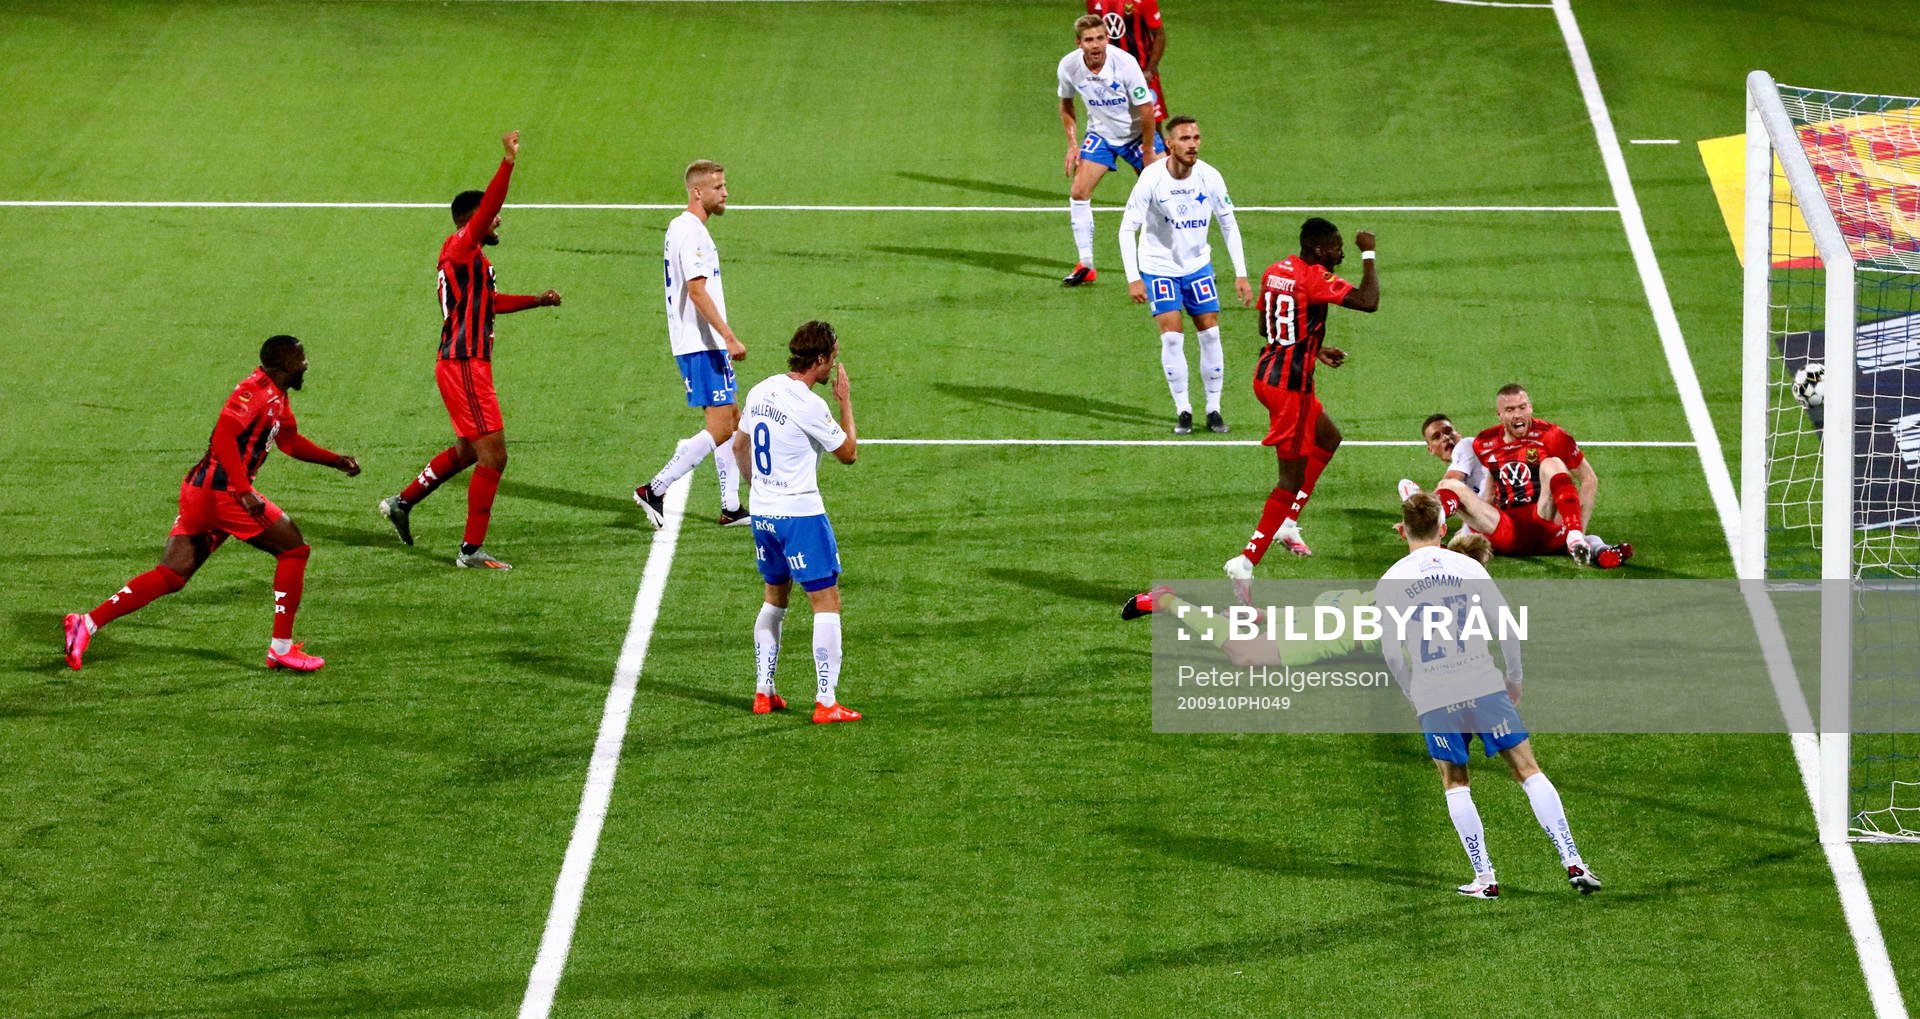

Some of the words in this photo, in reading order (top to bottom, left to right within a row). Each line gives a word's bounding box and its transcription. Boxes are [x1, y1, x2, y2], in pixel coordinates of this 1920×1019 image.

[1088, 97, 1127, 107] OLMEN
[1264, 291, 1295, 346] 18
[712, 390, 726, 401] 25
[751, 403, 787, 426] HALLENIUS
[754, 421, 771, 475] 8
[755, 520, 776, 534] RÖR
[786, 551, 808, 570] nt
[1405, 574, 1463, 599] BERGMANN
